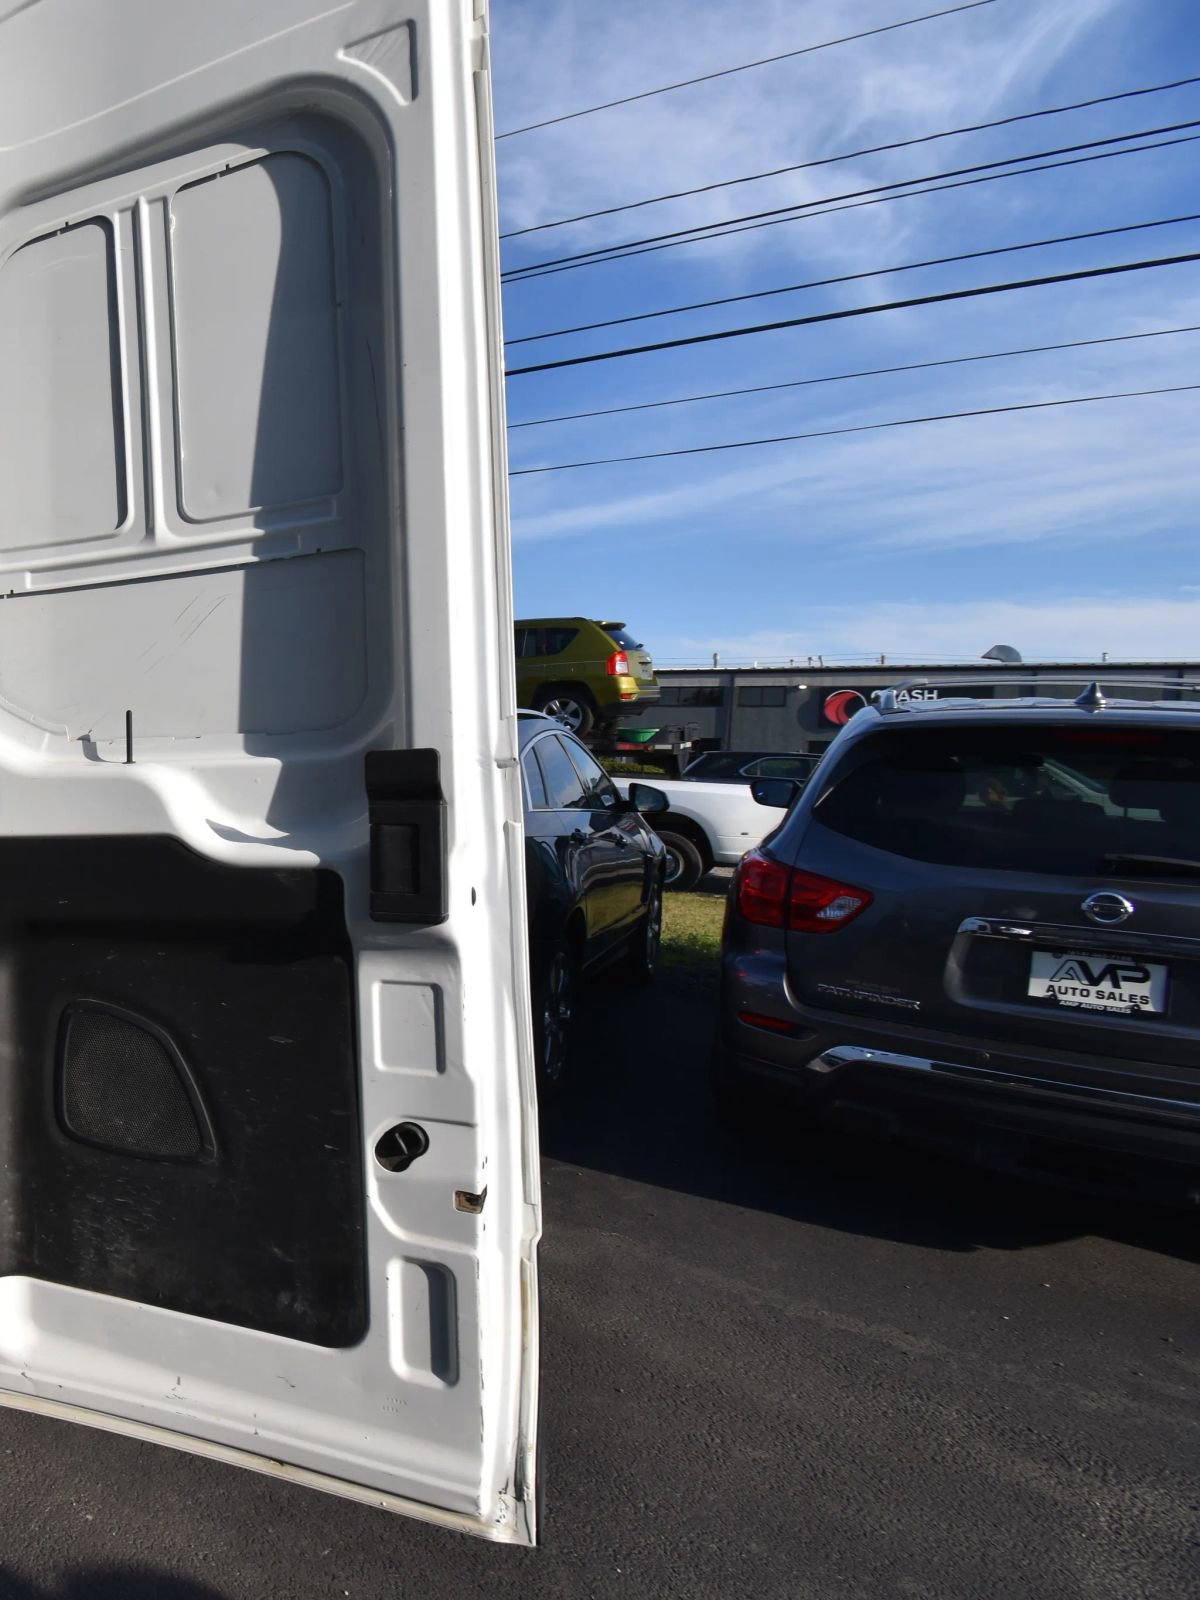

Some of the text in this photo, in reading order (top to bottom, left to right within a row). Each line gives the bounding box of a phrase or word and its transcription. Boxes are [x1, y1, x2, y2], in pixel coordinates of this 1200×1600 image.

[1049, 959, 1150, 989] AMP
[1046, 984, 1150, 1005] AUTO SALES
[1080, 1002, 1104, 1010] AUTO
